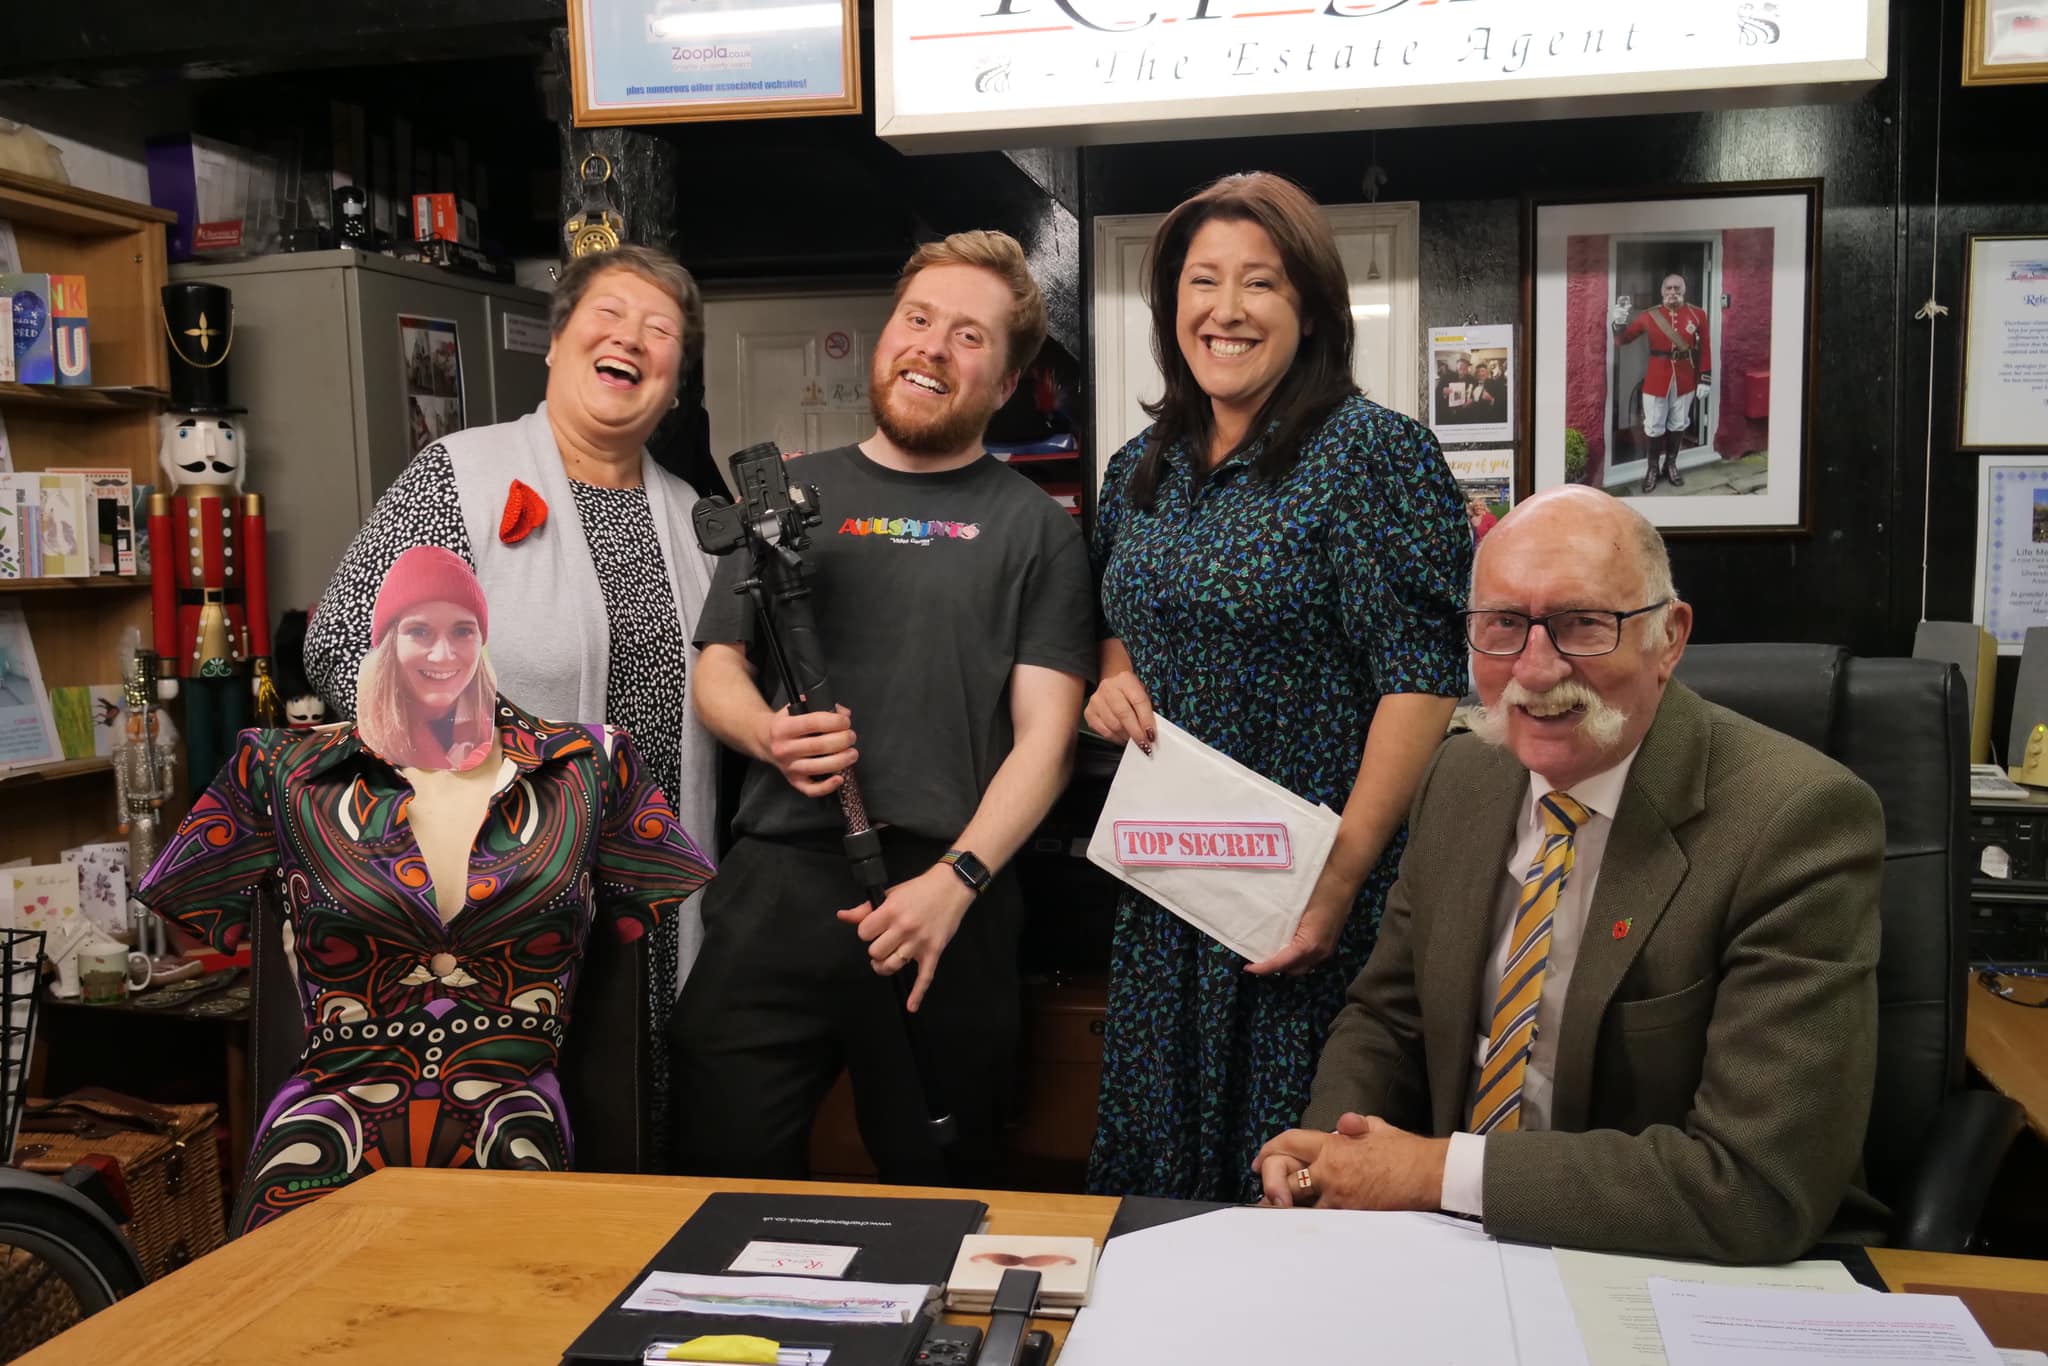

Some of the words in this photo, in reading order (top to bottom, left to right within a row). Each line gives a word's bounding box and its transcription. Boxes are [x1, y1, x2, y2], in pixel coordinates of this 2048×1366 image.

[1095, 47, 1189, 84] The
[1227, 40, 1418, 76] Estate
[1457, 23, 1639, 73] Agent
[626, 85, 645, 96] plus
[646, 83, 690, 95] numerous
[691, 81, 714, 92] other
[715, 80, 763, 92] associated
[764, 78, 808, 90] websites!
[1123, 831, 1175, 856] TOP
[1178, 832, 1280, 858] SECRET
